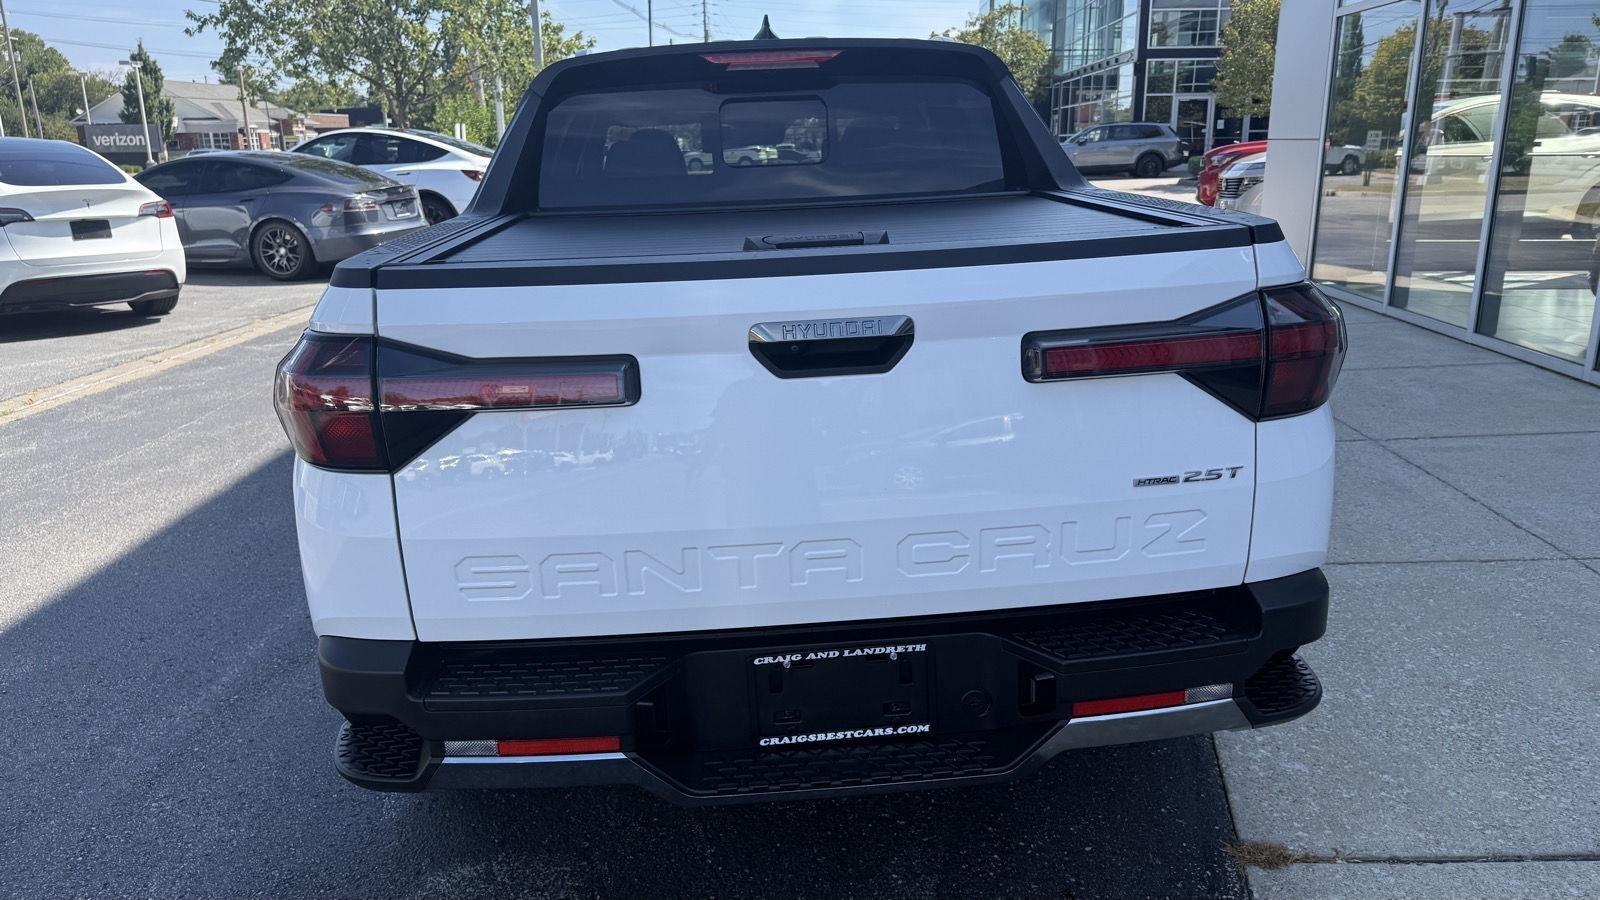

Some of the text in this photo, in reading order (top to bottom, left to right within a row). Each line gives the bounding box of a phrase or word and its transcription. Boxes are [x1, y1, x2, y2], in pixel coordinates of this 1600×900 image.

[92, 132, 145, 146] verizon
[782, 319, 883, 341] HYUNDAI
[1136, 476, 1177, 486] HTRAC
[454, 508, 1208, 602] SANTA CRUZ
[753, 644, 927, 665] CRAIG AND LANDRETH
[759, 724, 931, 746] CRAIGSBESTCARS.COM
